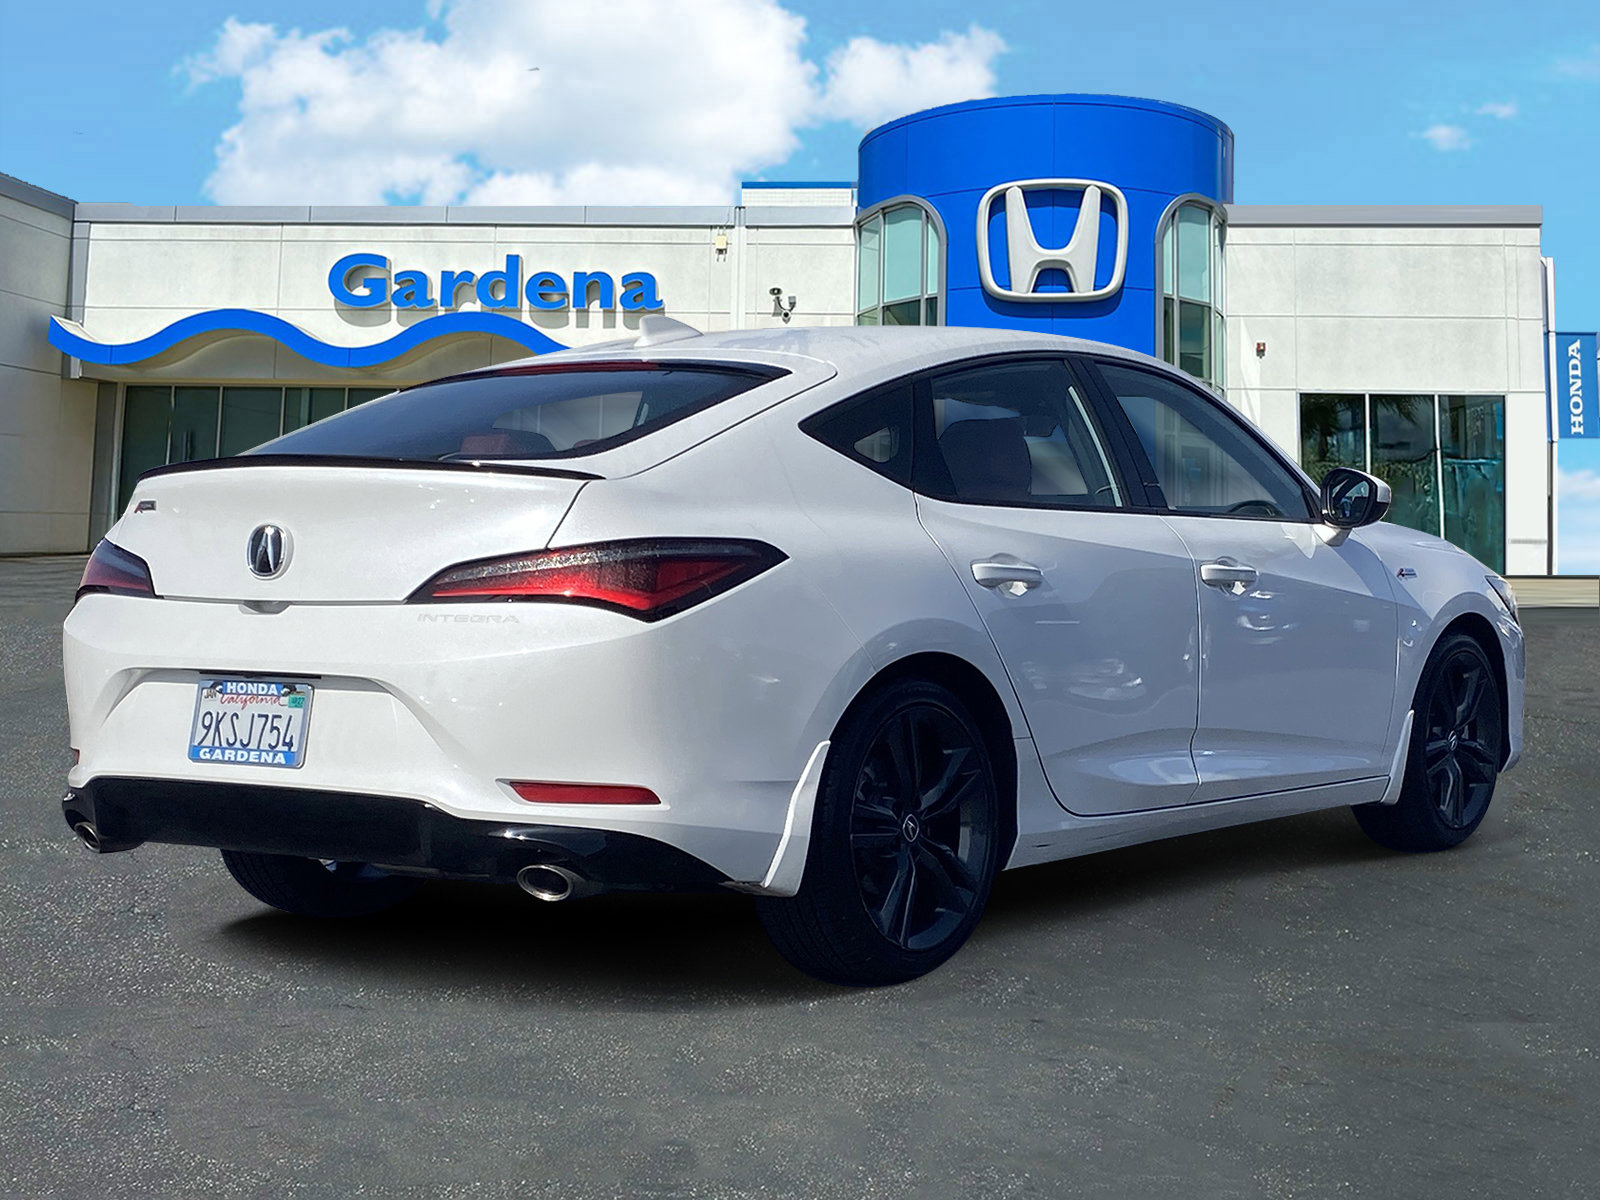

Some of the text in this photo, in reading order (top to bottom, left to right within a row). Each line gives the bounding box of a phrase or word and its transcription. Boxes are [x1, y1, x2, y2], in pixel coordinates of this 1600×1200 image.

[328, 252, 664, 310] Gardena
[1568, 339, 1584, 435] HONDA
[417, 614, 520, 623] INTEGRA
[227, 682, 278, 695] HONDA
[220, 694, 288, 710] California
[197, 711, 294, 751] 9KSJ754
[199, 748, 286, 764] GARDENA
